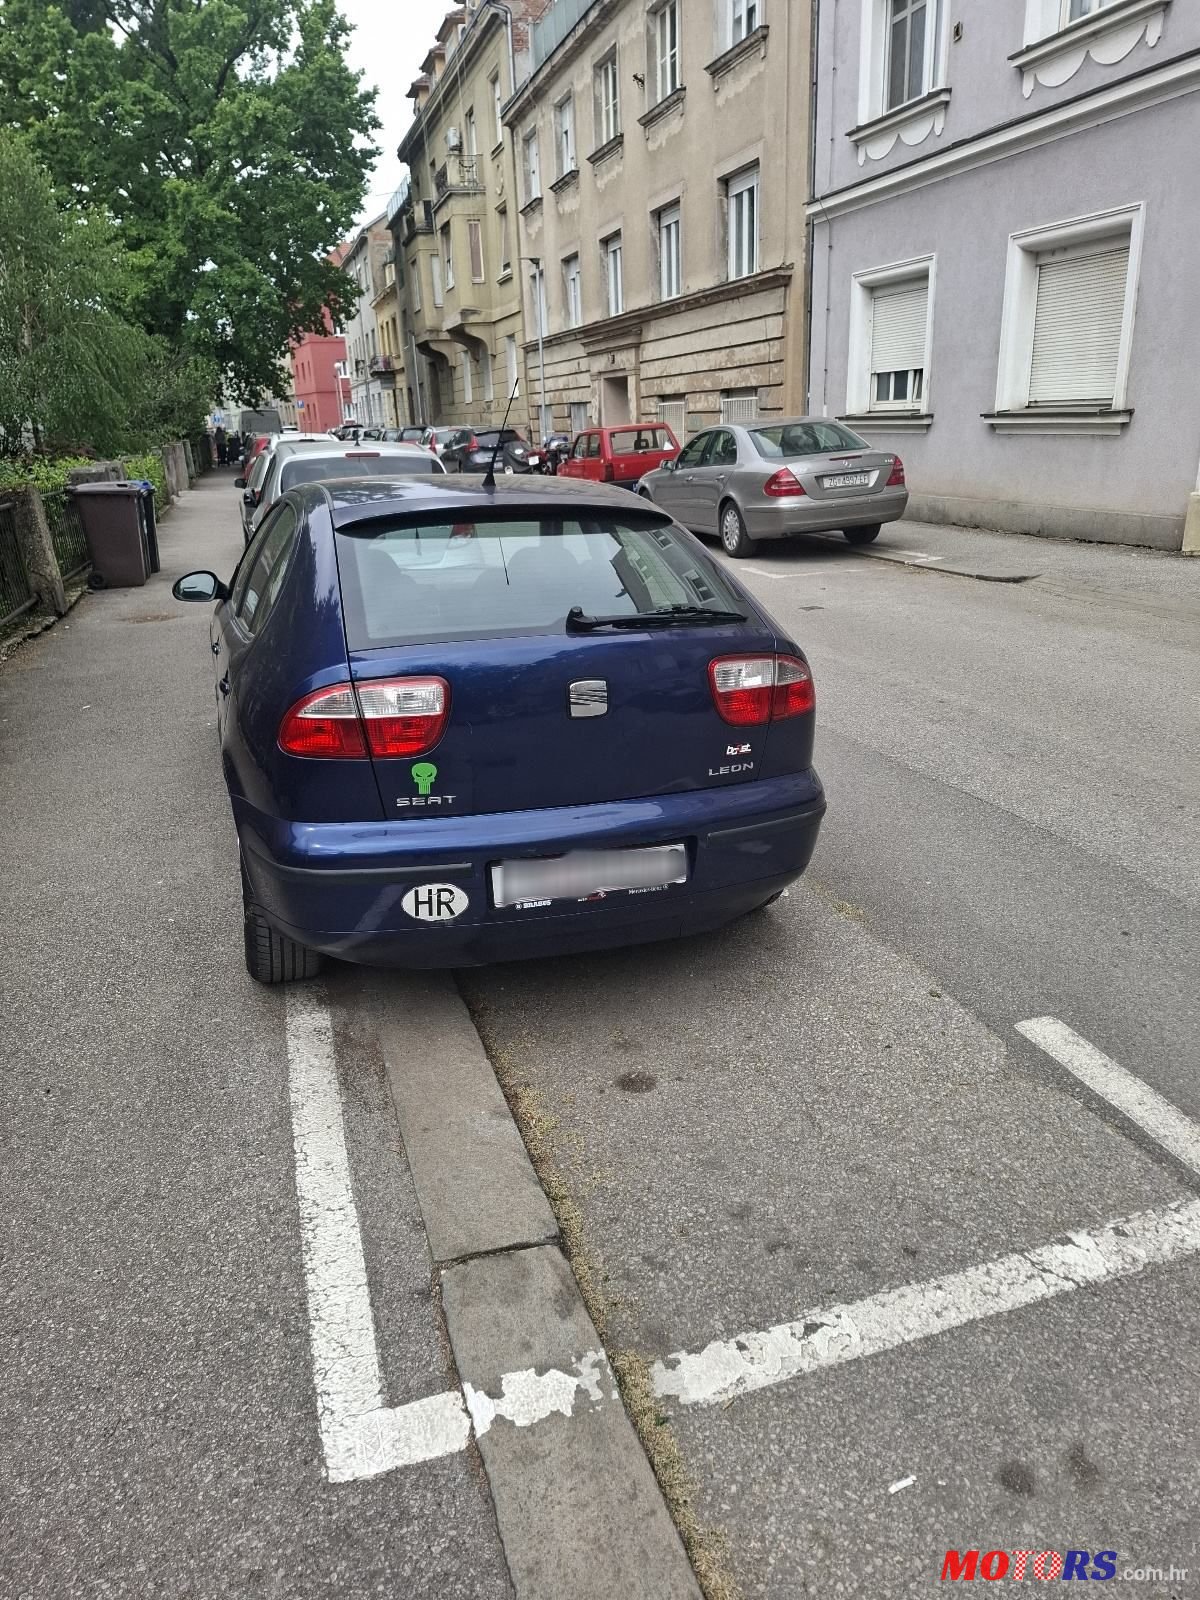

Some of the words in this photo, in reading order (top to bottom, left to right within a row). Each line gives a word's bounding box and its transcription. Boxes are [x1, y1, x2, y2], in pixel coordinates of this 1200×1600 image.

[708, 761, 754, 776] LEON
[396, 795, 457, 807] SEAT
[414, 888, 456, 917] HR
